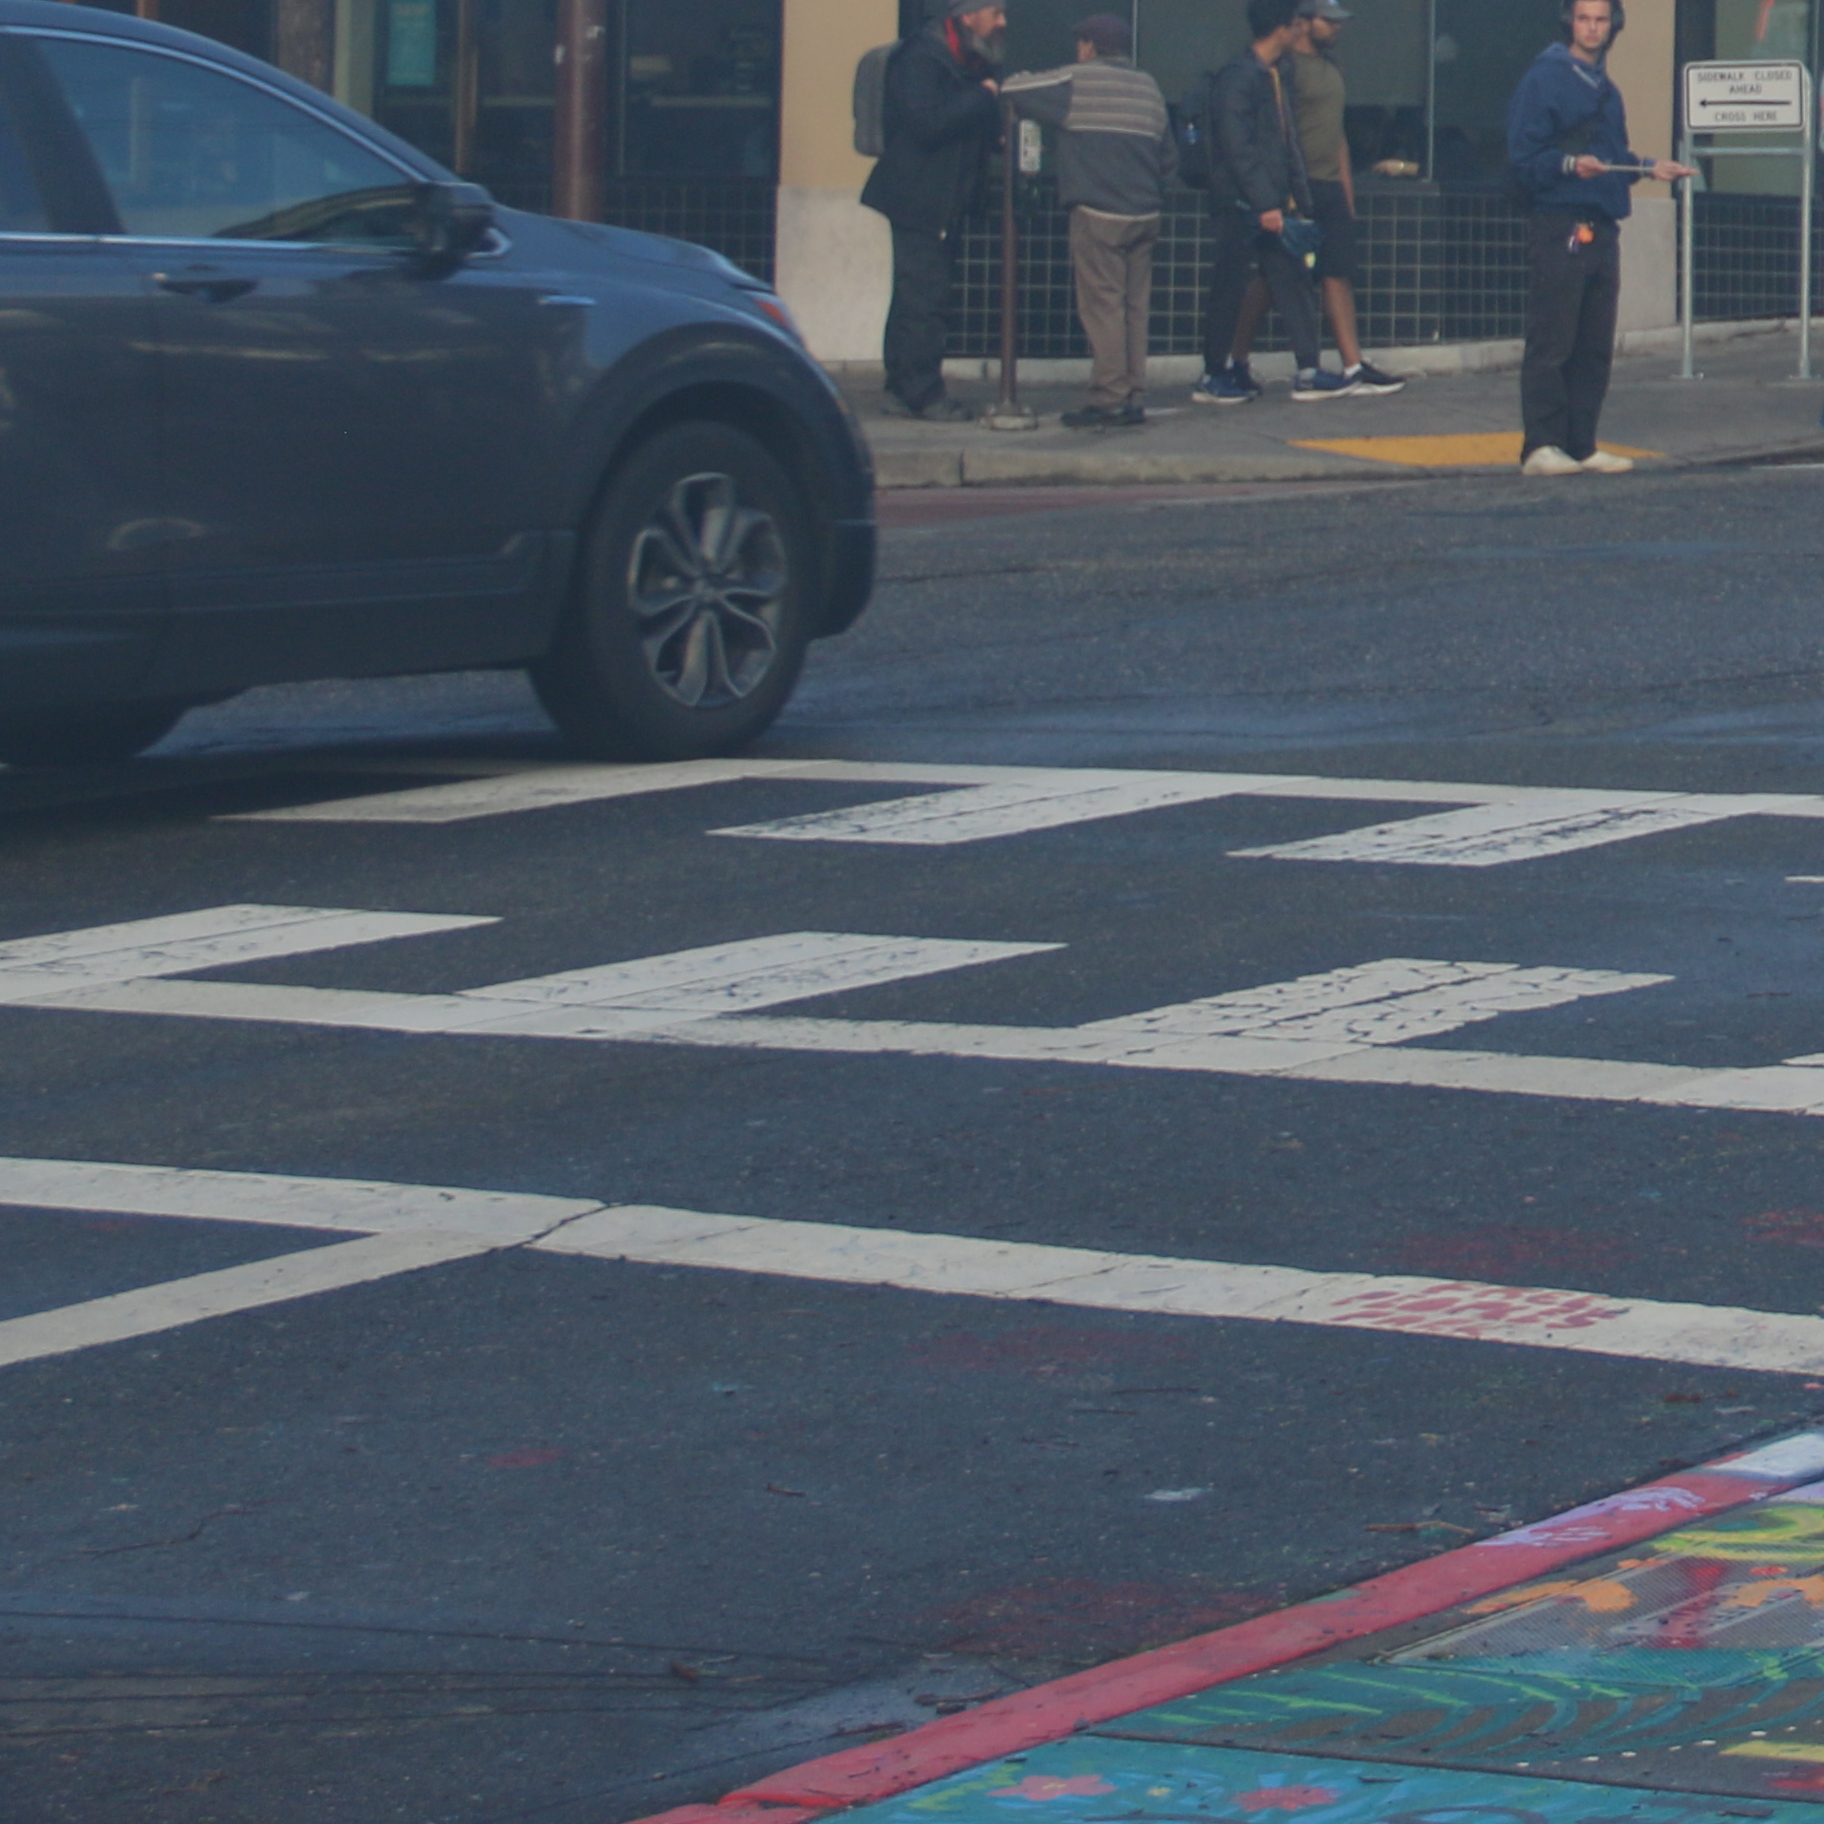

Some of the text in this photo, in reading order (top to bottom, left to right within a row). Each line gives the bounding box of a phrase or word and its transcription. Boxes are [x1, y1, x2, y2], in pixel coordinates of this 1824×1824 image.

[1697, 69, 1793, 82] SIDEWALK CLOSED
[1729, 84, 1763, 95] AHEAD
[1714, 110, 1778, 122] CROSS HERE
